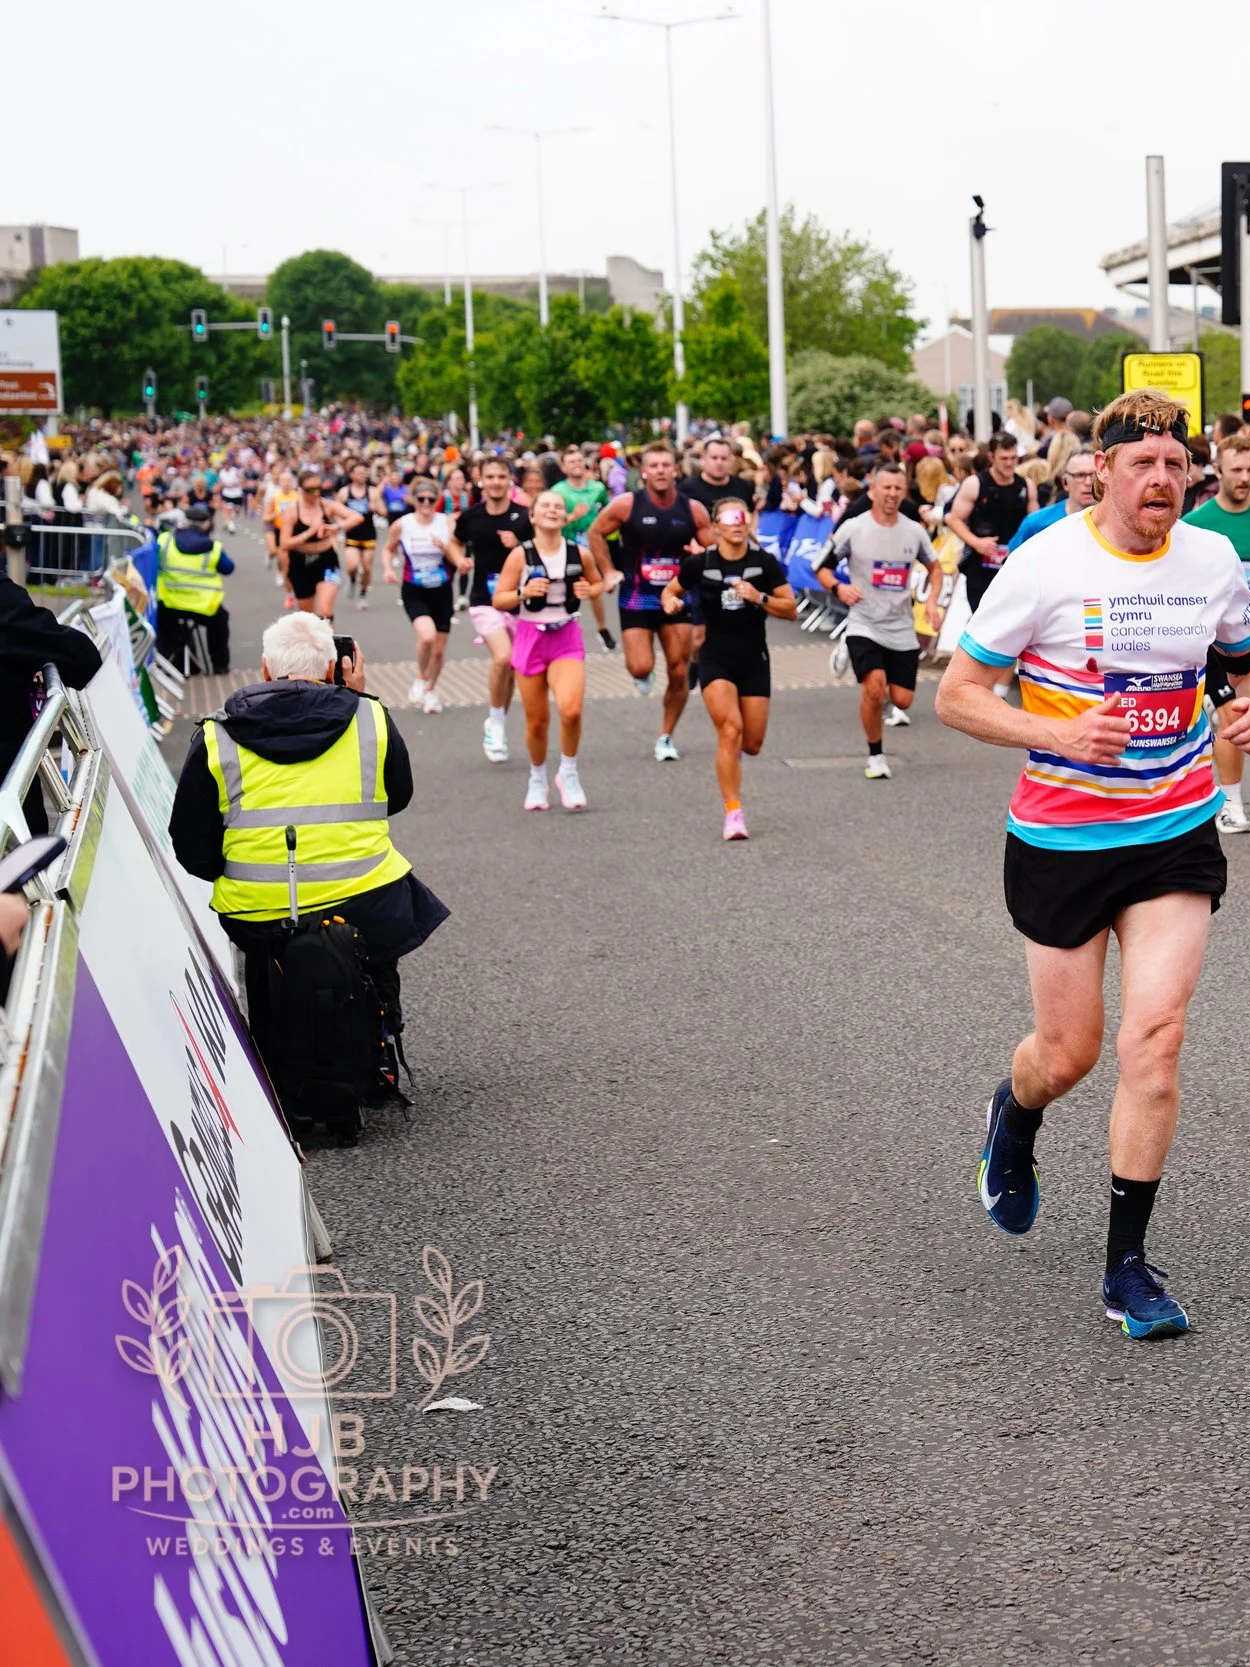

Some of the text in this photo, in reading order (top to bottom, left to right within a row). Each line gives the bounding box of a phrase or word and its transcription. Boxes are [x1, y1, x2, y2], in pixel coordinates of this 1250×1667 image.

[1109, 593, 1208, 609] ymchwil canser
[1110, 611, 1152, 622] cymru
[1111, 623, 1208, 637] cancer research
[1111, 640, 1151, 652] wales
[1153, 672, 1183, 683] SWANSEA
[1124, 706, 1180, 733] 6394
